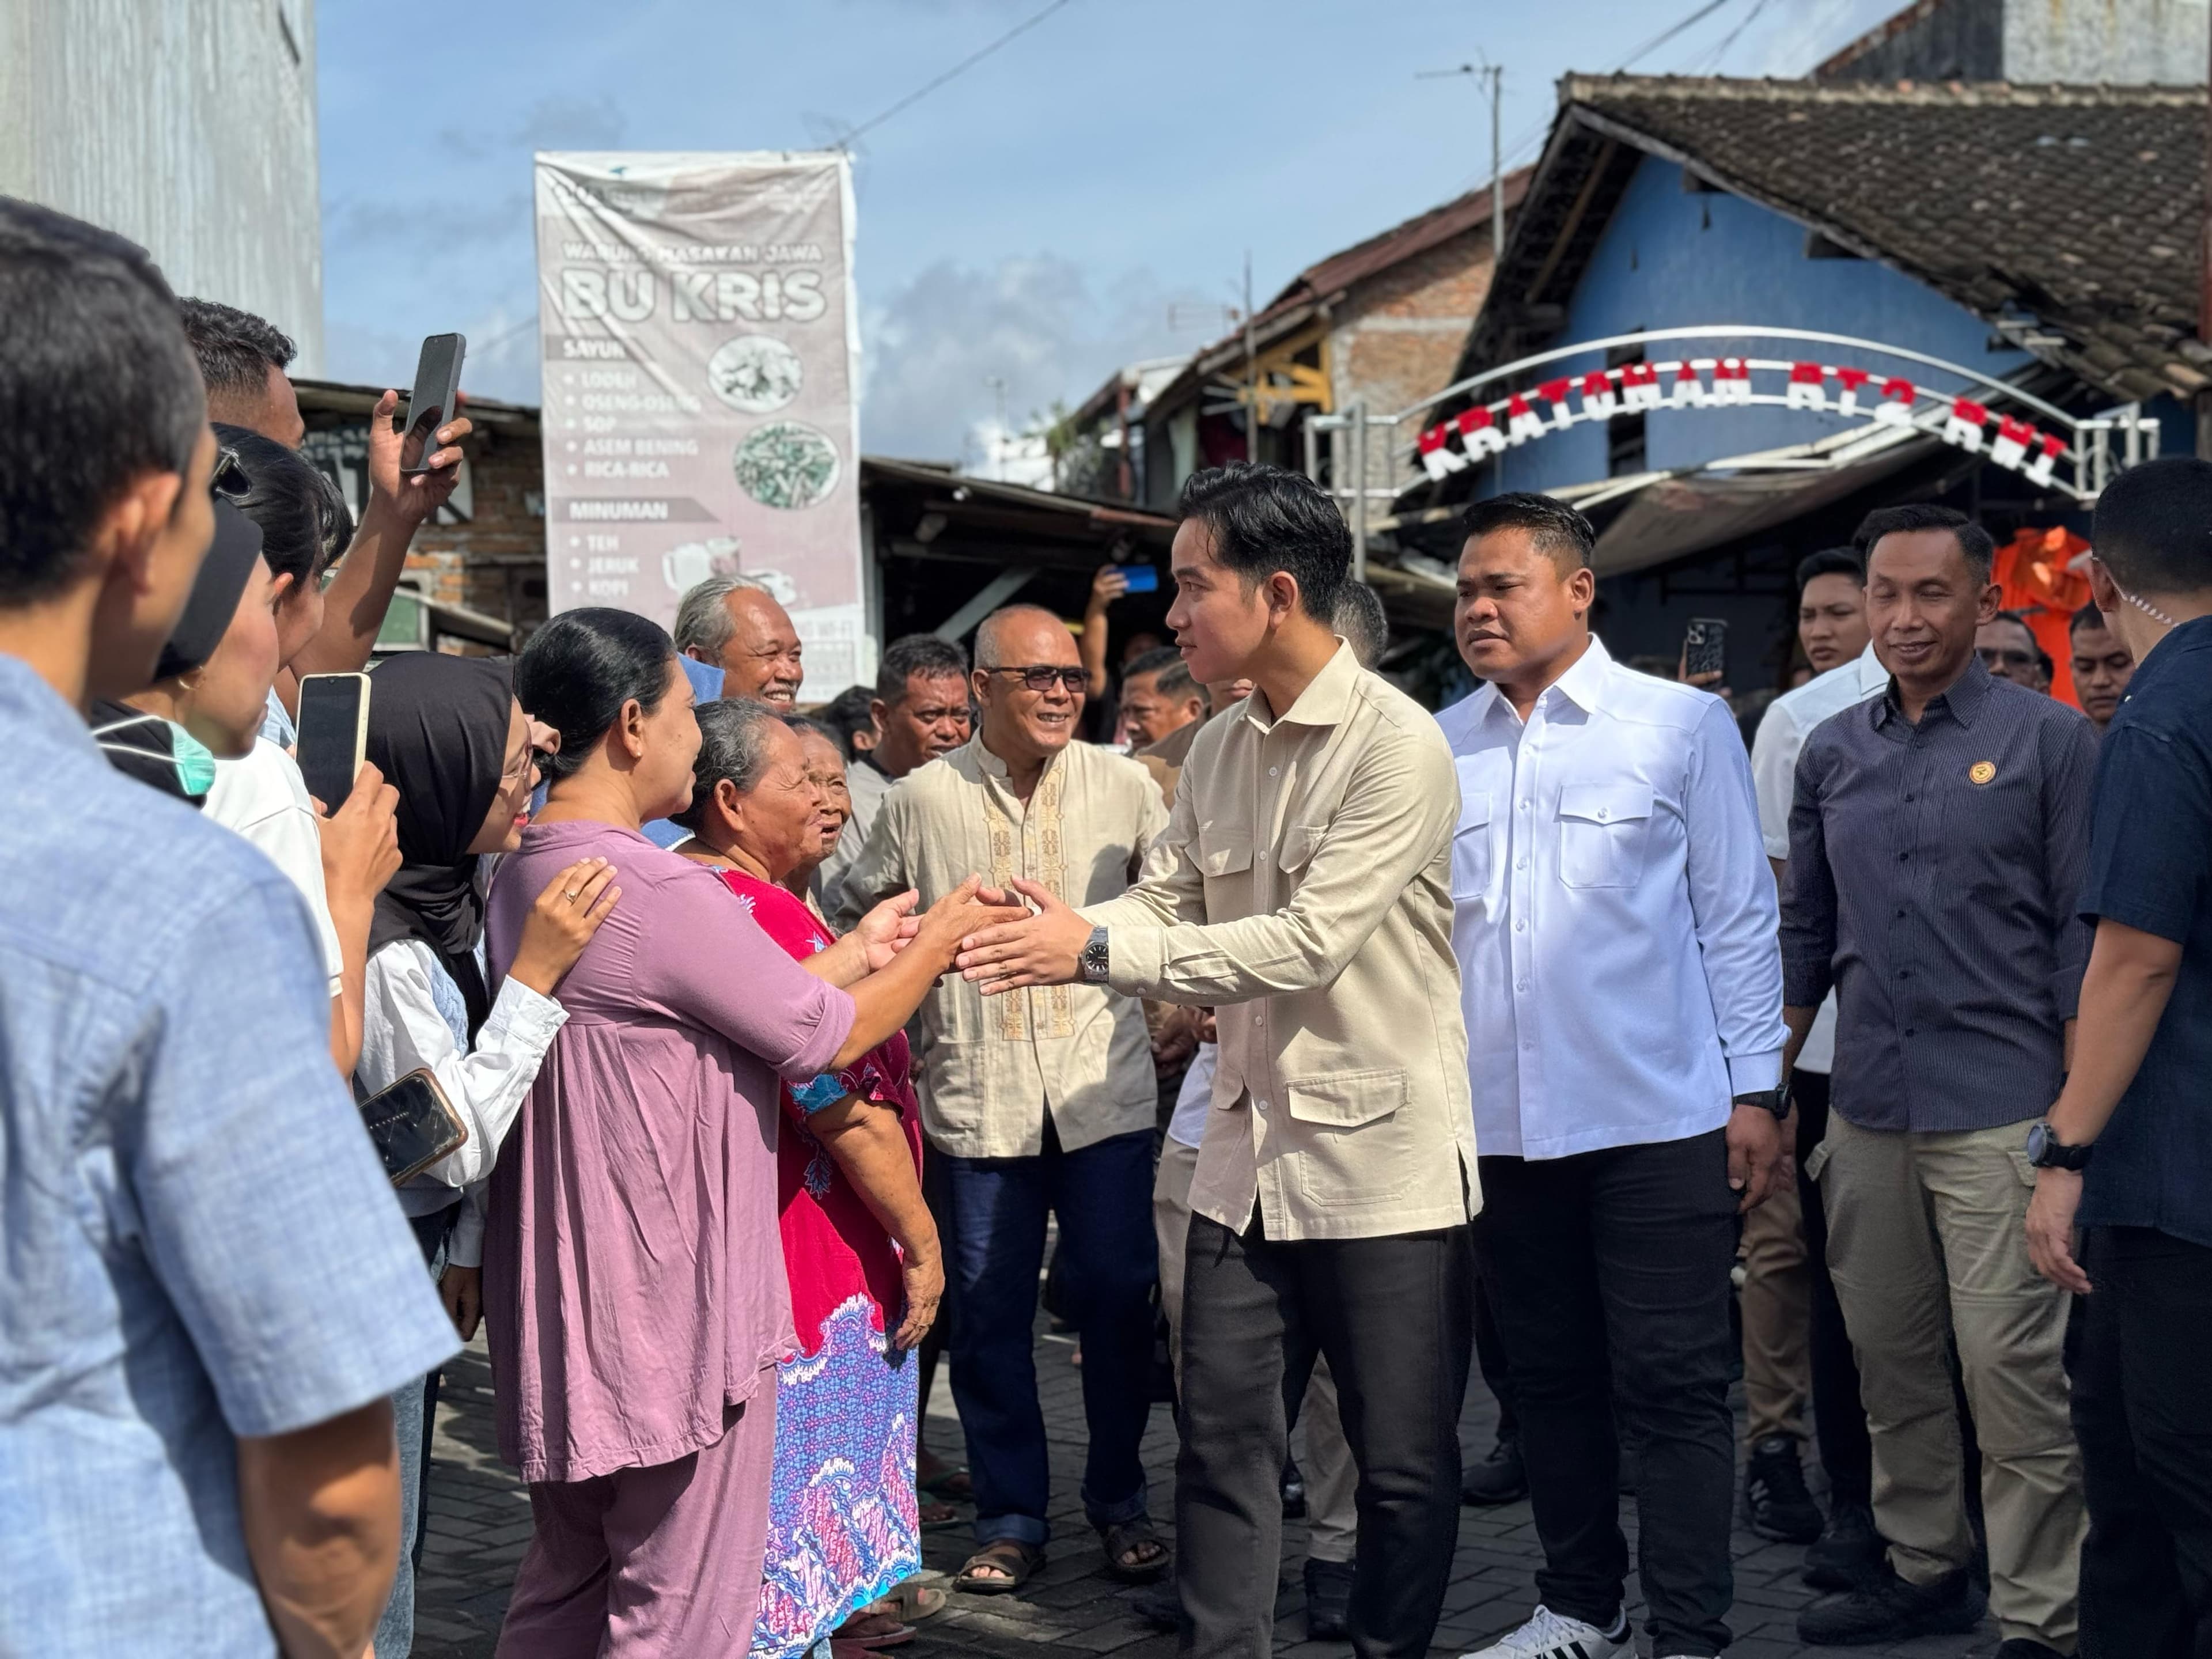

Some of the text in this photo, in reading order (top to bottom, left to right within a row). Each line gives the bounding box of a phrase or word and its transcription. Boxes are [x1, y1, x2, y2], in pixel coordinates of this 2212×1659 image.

[658, 244, 759, 263] MASAKAN
[766, 244, 823, 262] JAWA
[562, 269, 827, 323] BU KRIS
[563, 339, 626, 359] SAYUR
[583, 415, 618, 433] SOP
[584, 438, 699, 456] ASEM BENING
[584, 460, 671, 479] RICA-RICA
[569, 501, 669, 520] MINUMAN
[587, 534, 620, 552] TEH
[588, 556, 640, 574] JERUK
[588, 578, 630, 597] KOPI
